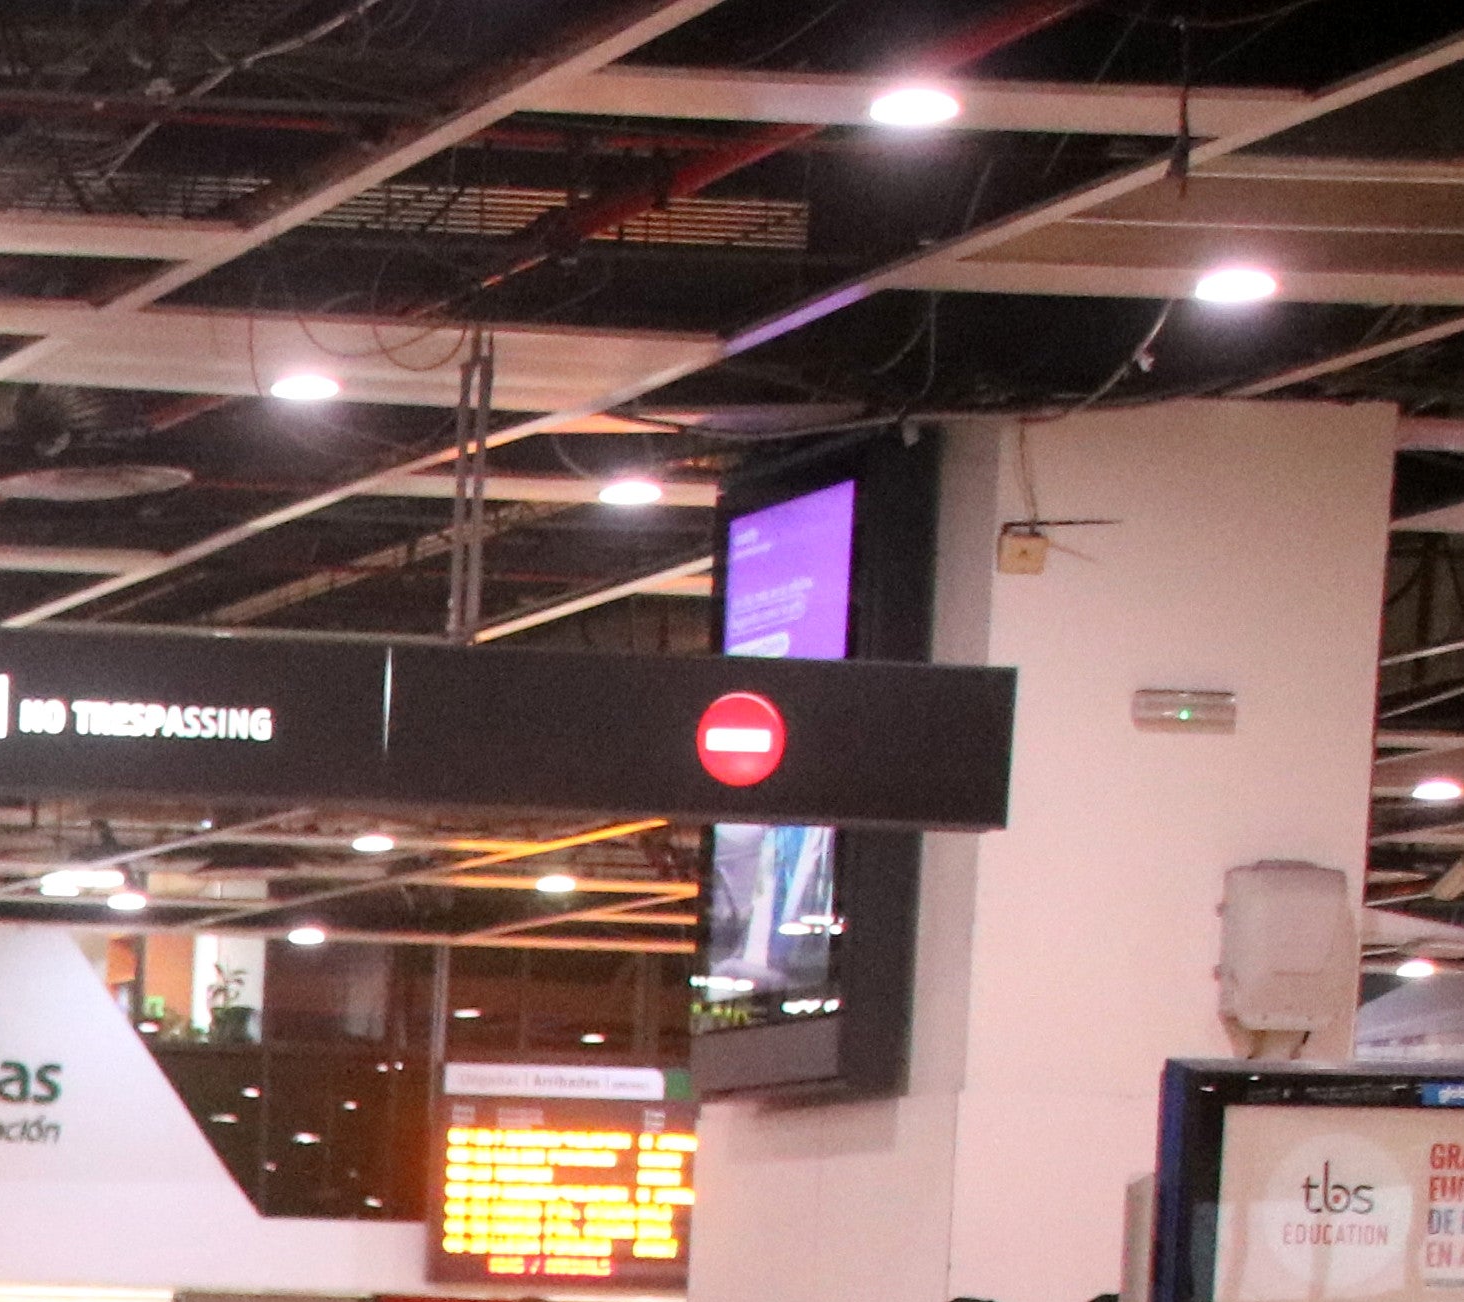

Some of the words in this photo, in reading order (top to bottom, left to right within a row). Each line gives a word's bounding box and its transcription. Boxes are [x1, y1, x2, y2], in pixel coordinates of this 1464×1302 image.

[19, 698, 67, 735] NO
[71, 700, 273, 742] TRESPASSING
[1429, 1142, 1464, 1171] GR
[1300, 1159, 1374, 1215] tbs
[1282, 1223, 1390, 1248] EDUCATION
